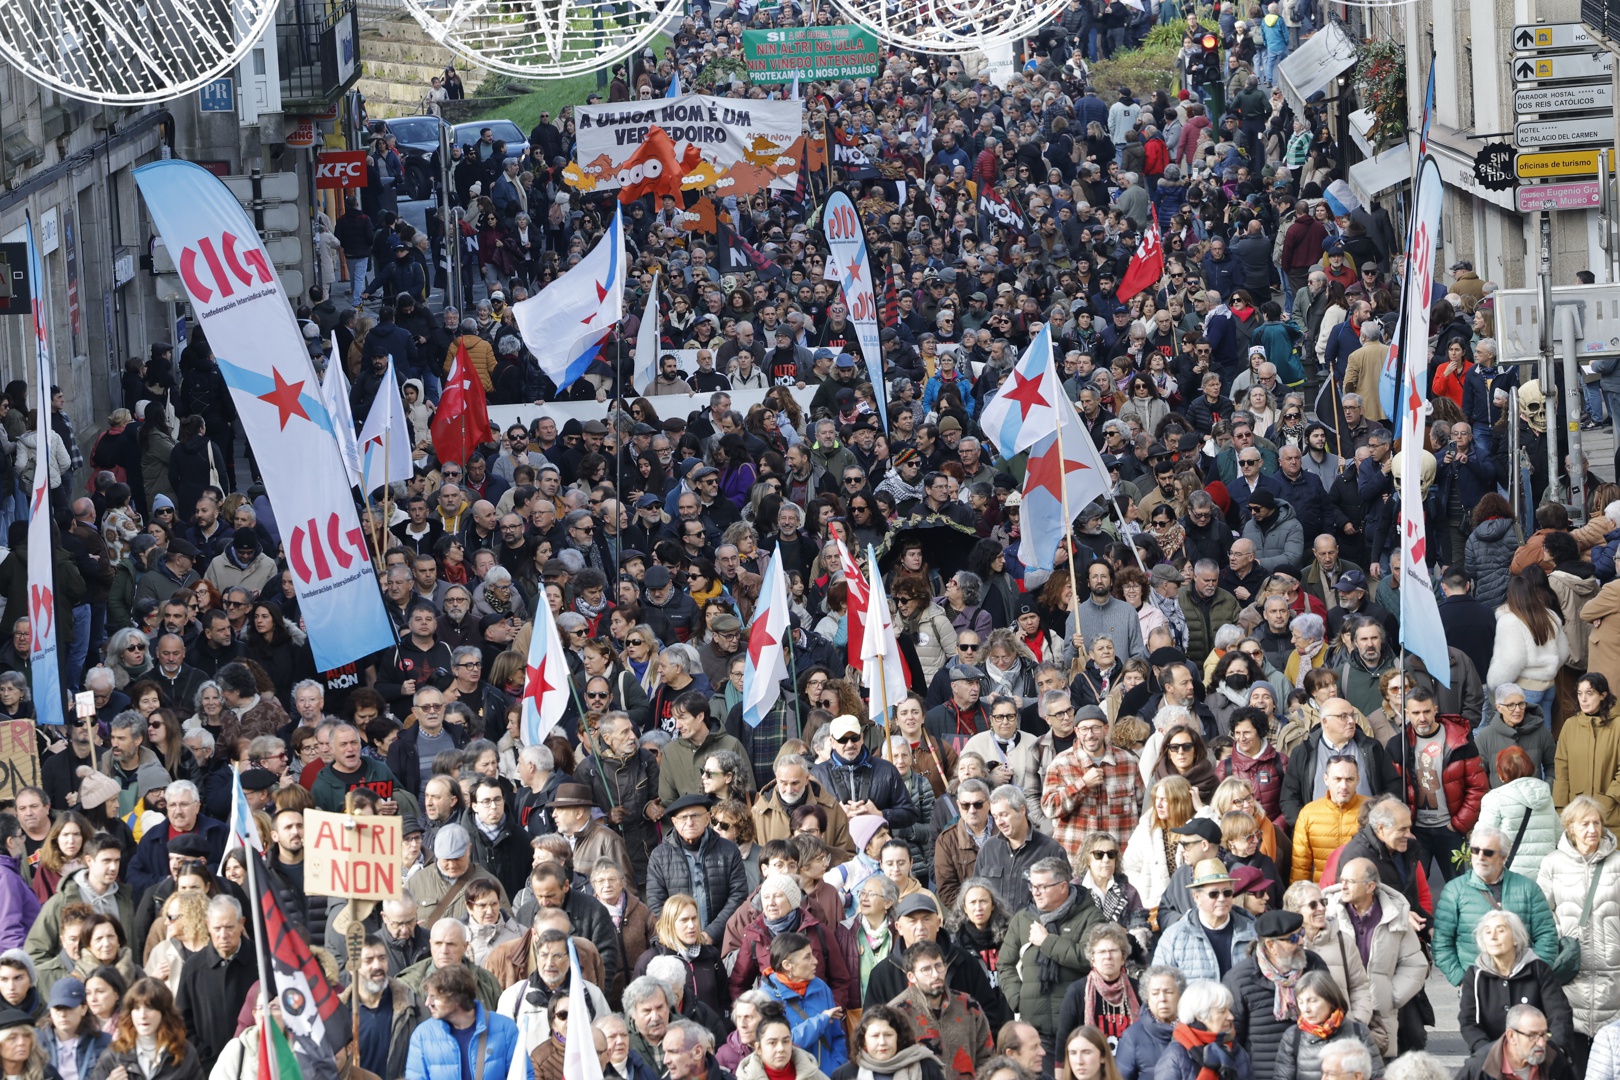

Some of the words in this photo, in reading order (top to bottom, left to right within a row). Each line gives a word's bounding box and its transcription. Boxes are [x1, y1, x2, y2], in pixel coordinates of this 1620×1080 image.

[766, 32, 786, 42] SI
[795, 31, 805, 40] UN
[808, 30, 830, 39] RURAL
[832, 29, 849, 38] VIVO
[756, 43, 777, 56] NIN
[780, 42, 812, 54] ALTRI
[815, 40, 831, 52] NO
[835, 38, 864, 51] ULLA
[746, 59, 766, 71] NIN
[769, 54, 812, 70] VIÑEDO
[815, 53, 876, 67] INTENSIVO
[808, 70, 814, 78] O
[816, 68, 839, 78] NOSO
[841, 65, 877, 76] PARAÍSO
[204, 83, 228, 100] PR
[1554, 98, 1594, 106] CATÓLICOS
[579, 114, 592, 129] A
[596, 109, 656, 127] ULHOA
[661, 105, 704, 122] NOM
[709, 101, 717, 121] É
[722, 108, 752, 126] UM
[614, 125, 727, 145] VEREDOIRO
[316, 162, 361, 178] KFC
[1520, 162, 1549, 170] oficinas
[1562, 159, 1591, 168] turismo
[1547, 187, 1580, 197] Eugenio
[1560, 197, 1588, 205] Museo
[180, 231, 274, 304] CIG
[290, 512, 369, 584] CIG
[327, 673, 358, 689] NON
[314, 821, 394, 855] ALTRI
[331, 859, 394, 894] NON
